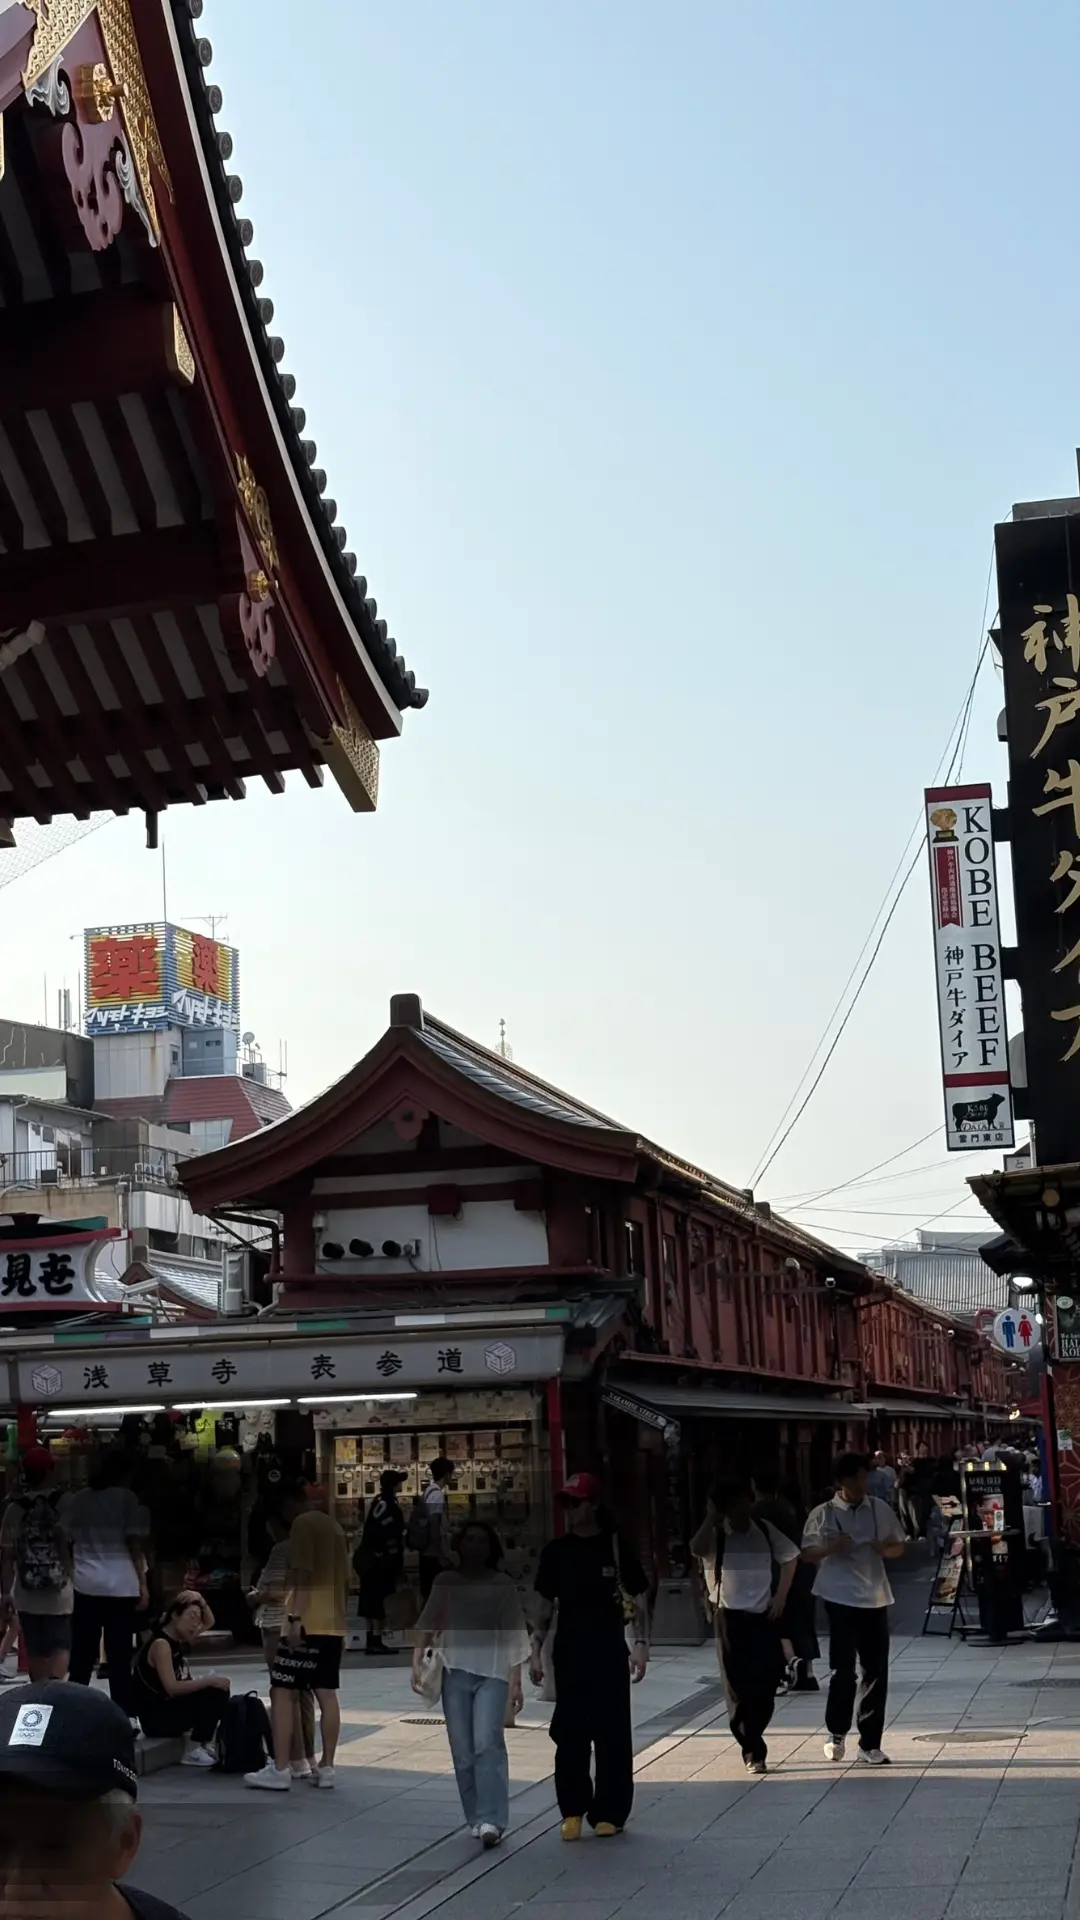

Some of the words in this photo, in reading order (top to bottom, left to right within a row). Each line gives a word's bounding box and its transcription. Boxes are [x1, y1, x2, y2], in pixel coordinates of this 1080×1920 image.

[962, 806, 993, 927] KOBE
[90, 936, 159, 999] 薬
[192, 934, 220, 994] 薬
[83, 1003, 170, 1028] マツモトキヨシ
[172, 988, 239, 1028] マツモトキヨシ
[944, 946, 970, 1068] 神戸牛ダイア
[971, 943, 1001, 1067] BEEF
[1, 1252, 75, 1297] 見世
[83, 1358, 238, 1391] 浅草寺
[310, 1347, 465, 1380] 表参道
